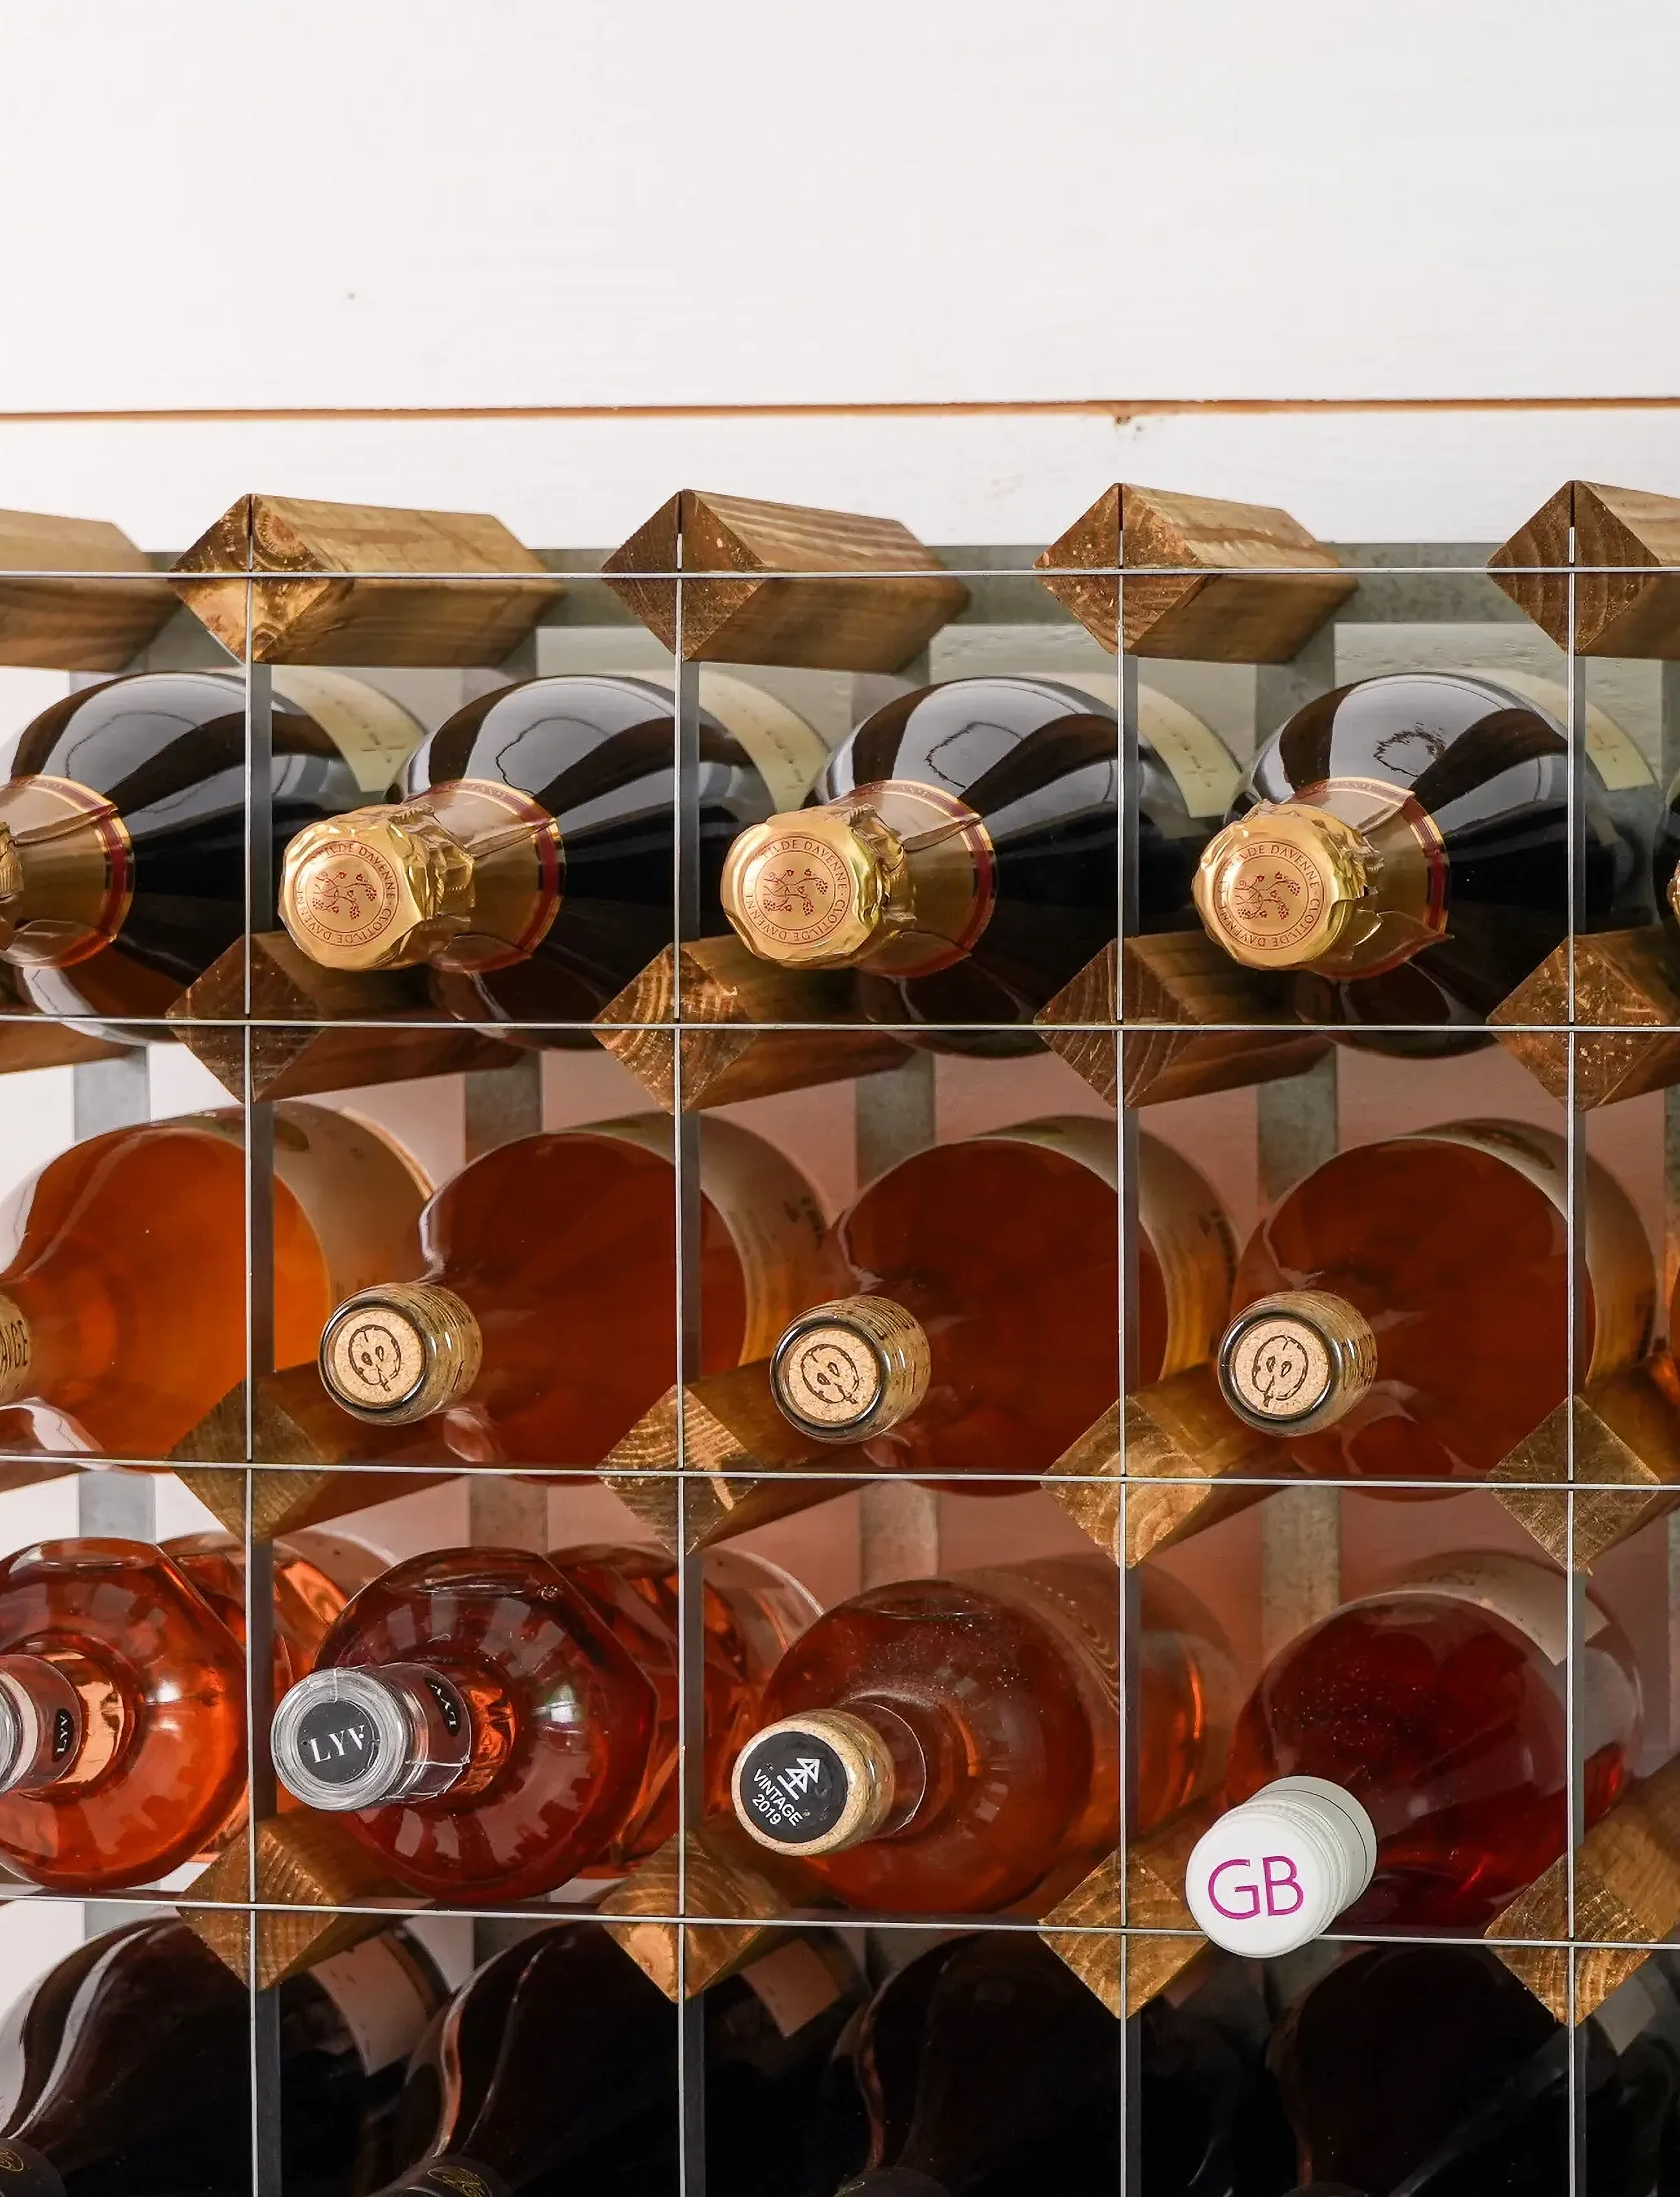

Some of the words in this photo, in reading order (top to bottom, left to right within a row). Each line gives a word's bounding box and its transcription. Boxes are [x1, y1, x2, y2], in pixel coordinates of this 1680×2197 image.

[803, 839, 848, 888] DAVENNE
[1269, 845, 1320, 888] DAVENNE
[752, 1794, 782, 1825] 2019
[753, 1769, 803, 1827] VINTAGE
[1208, 1855, 1304, 1920] GB
